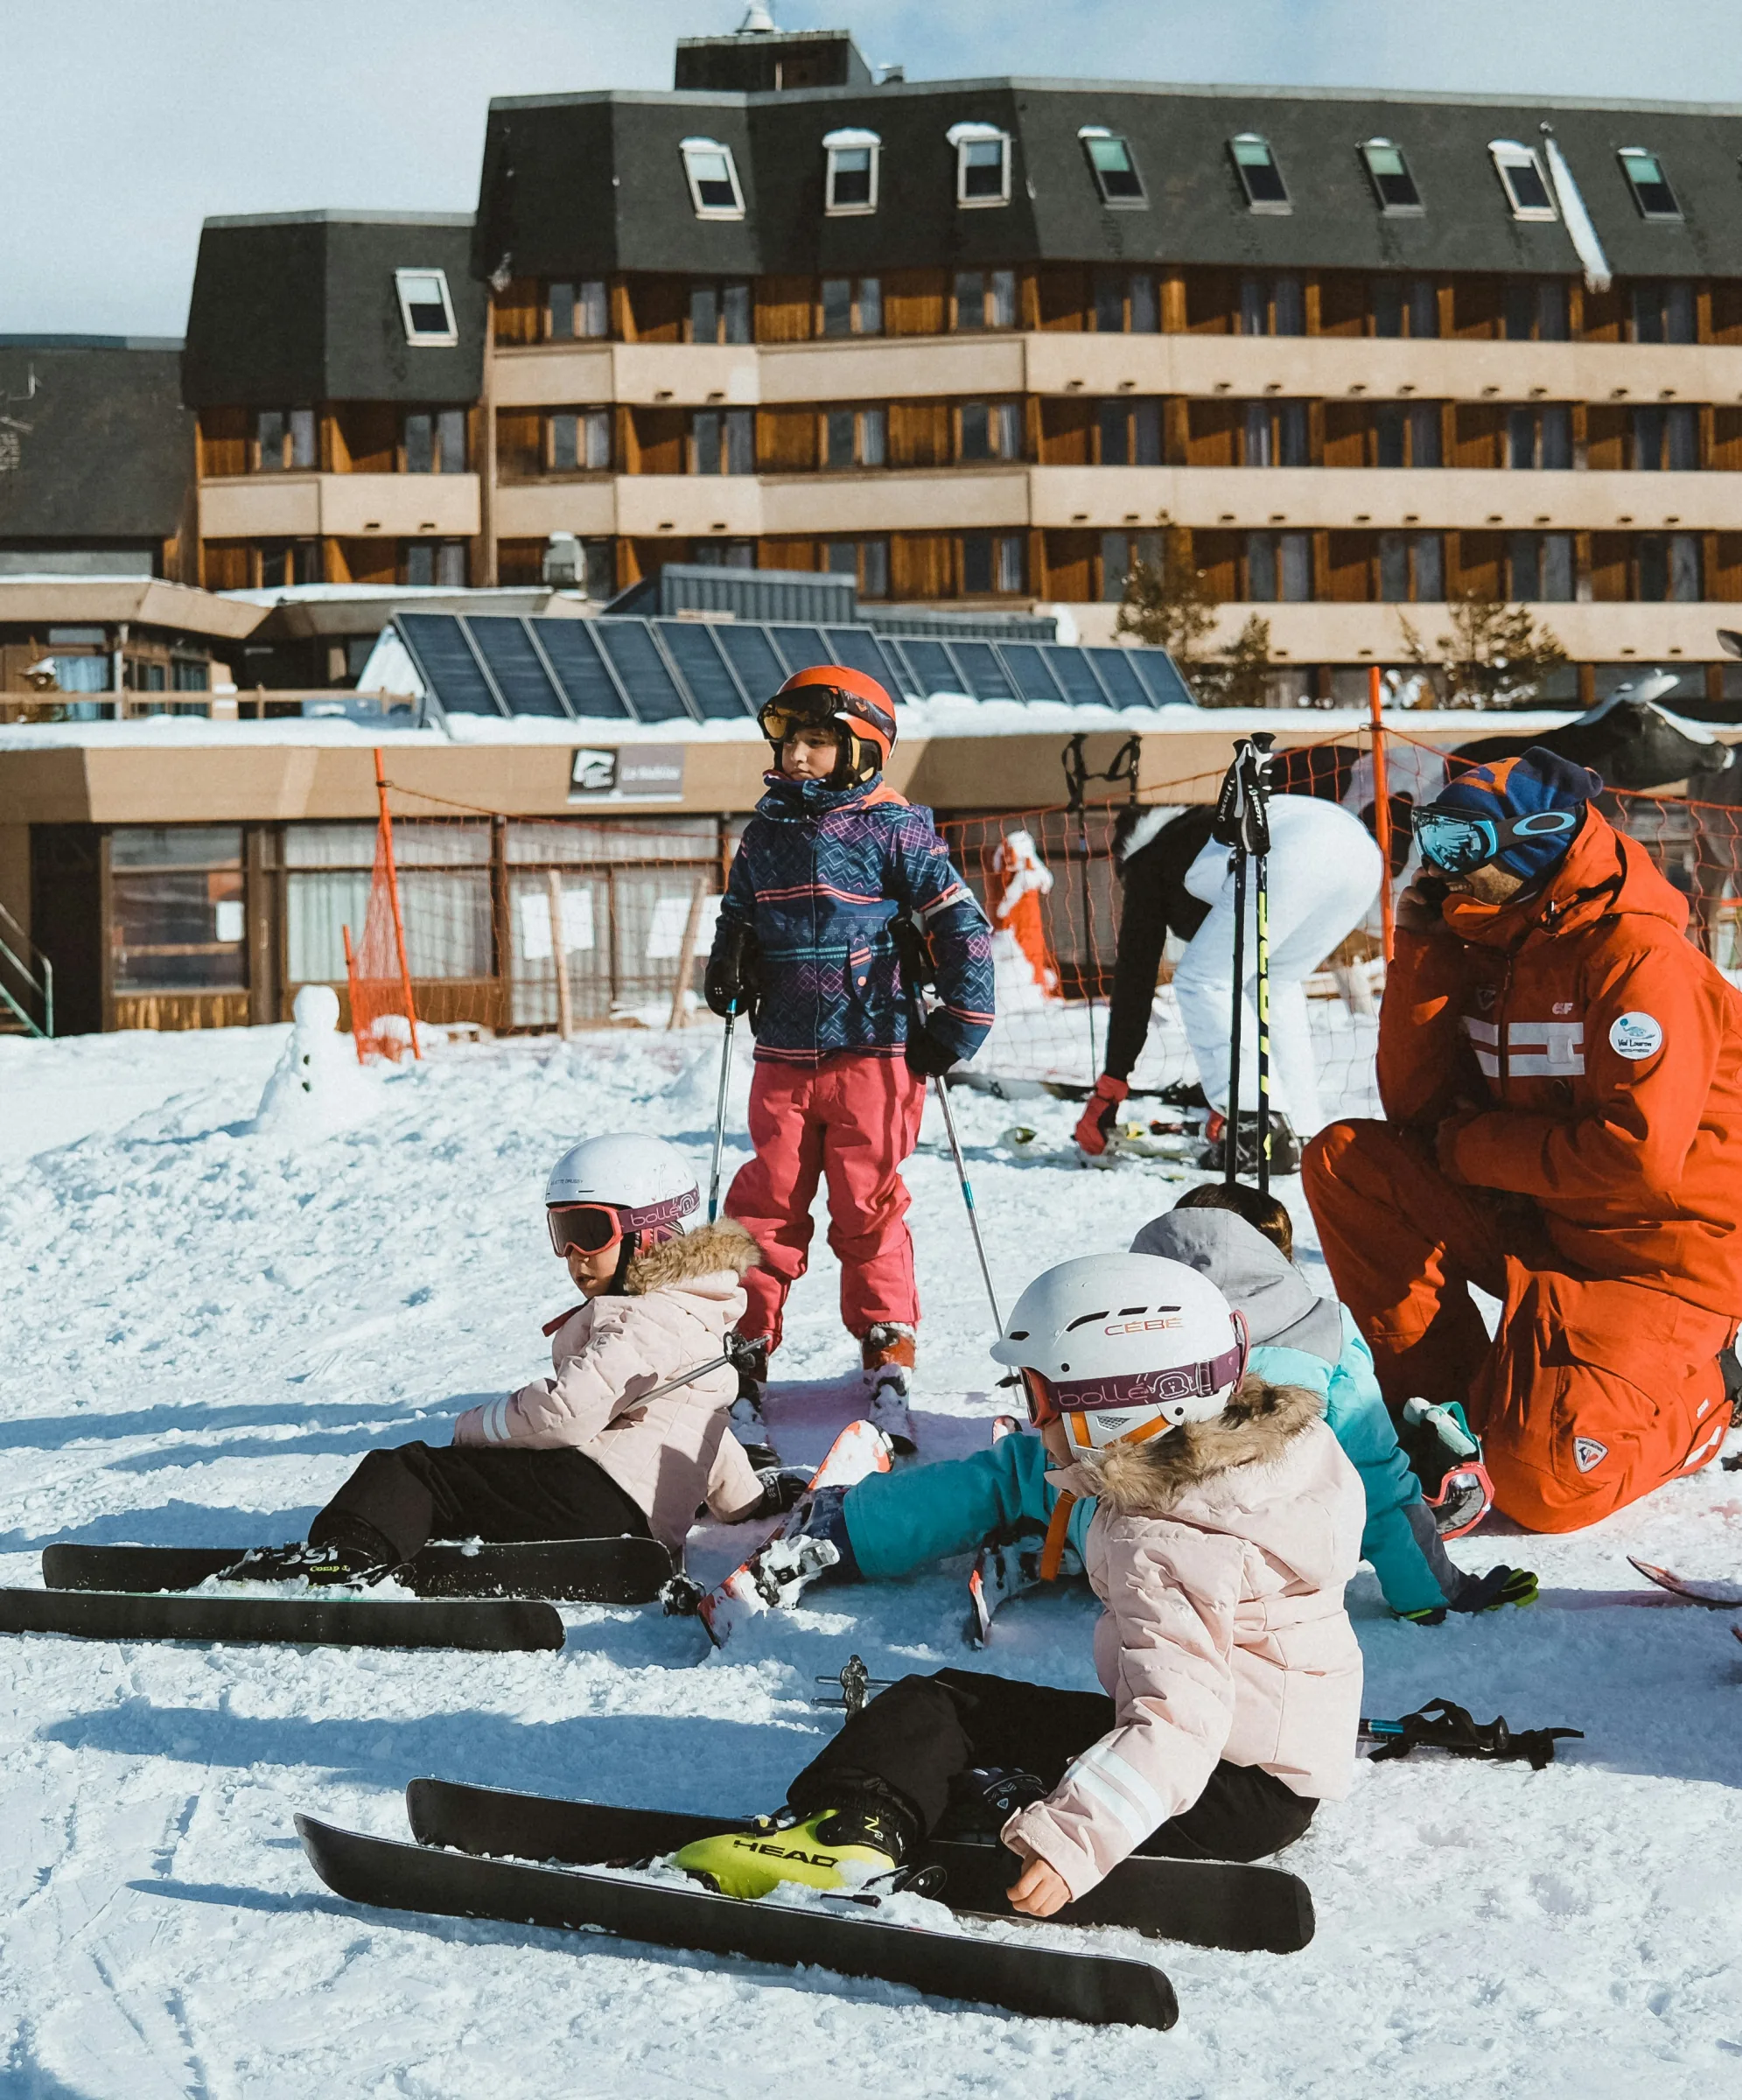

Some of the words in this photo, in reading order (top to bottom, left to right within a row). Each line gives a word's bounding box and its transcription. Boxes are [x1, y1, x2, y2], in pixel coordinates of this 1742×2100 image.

[631, 1204, 680, 1227] bollé
[1104, 1317, 1184, 1336] CÉBÉ
[1058, 1381, 1149, 1406] bollé
[733, 1839, 839, 1868] HEAD
